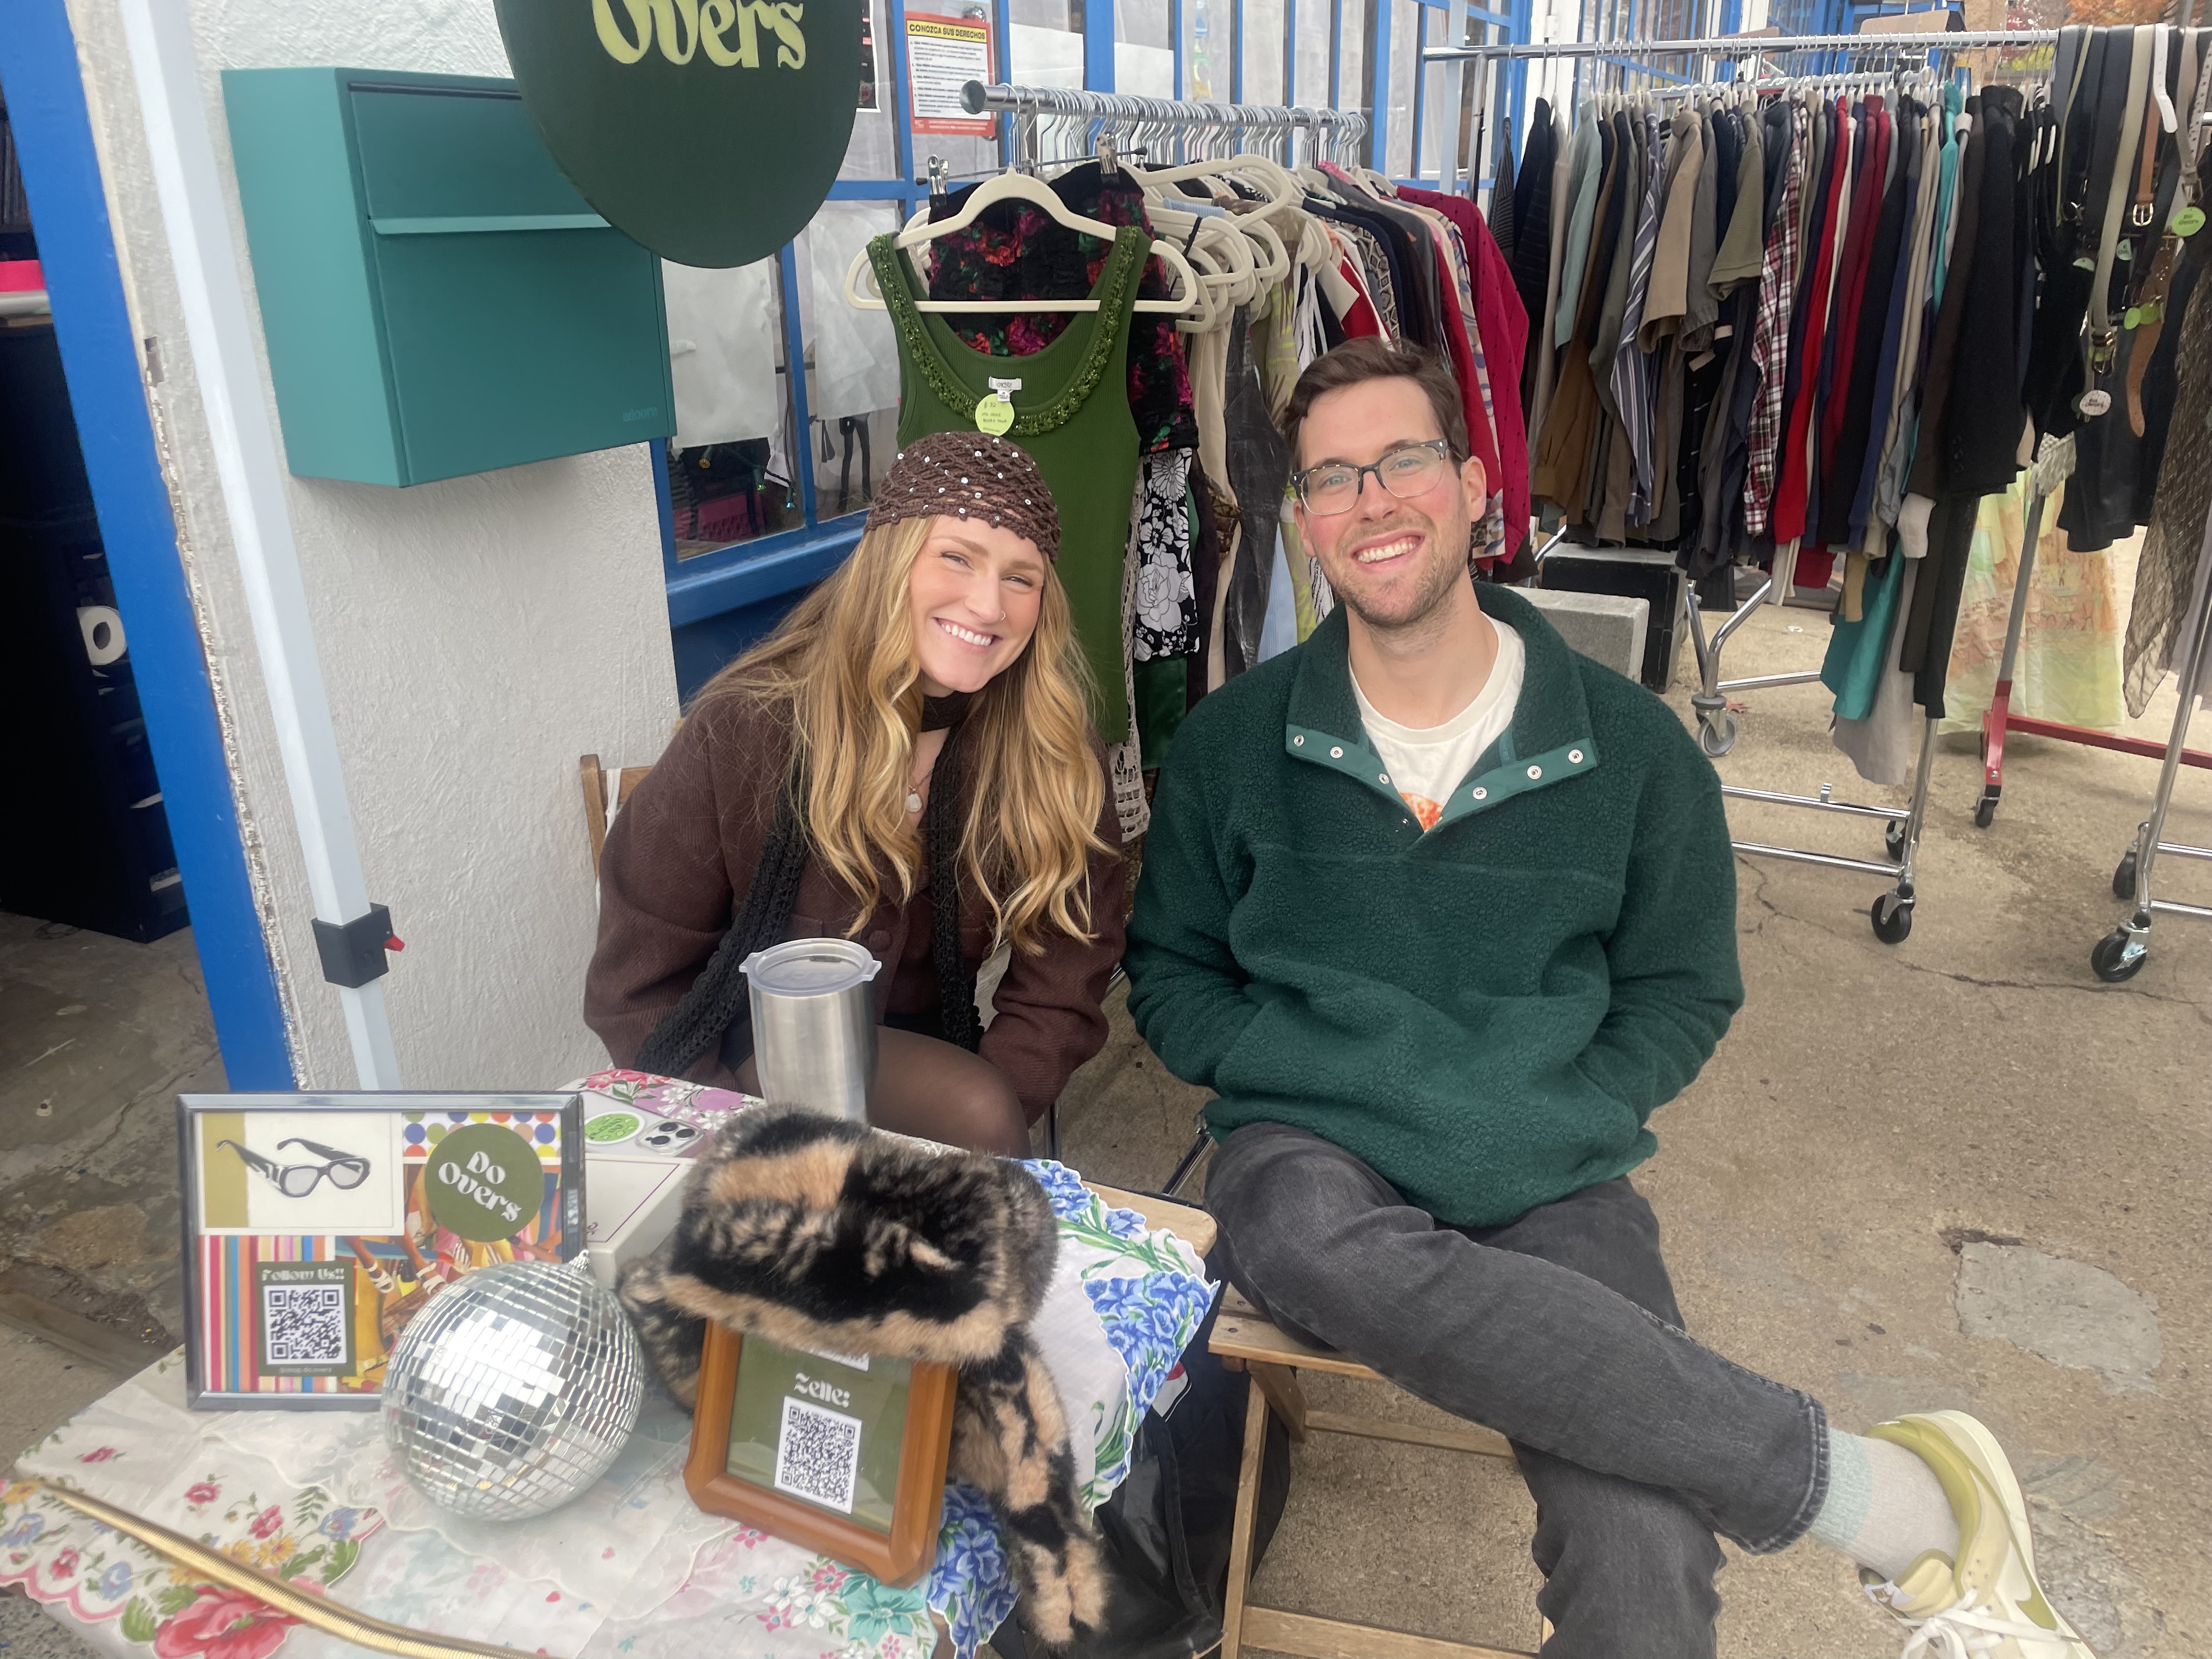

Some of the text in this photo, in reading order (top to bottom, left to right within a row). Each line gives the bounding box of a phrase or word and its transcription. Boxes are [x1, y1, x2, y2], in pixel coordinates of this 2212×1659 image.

[910, 24, 986, 40] CONOZCA SUS DERECHOS
[466, 1150, 506, 1184] Do
[438, 1161, 522, 1222] Overs
[261, 1268, 345, 1282] Follow Us!!
[793, 1372, 851, 1408] Zelle:
